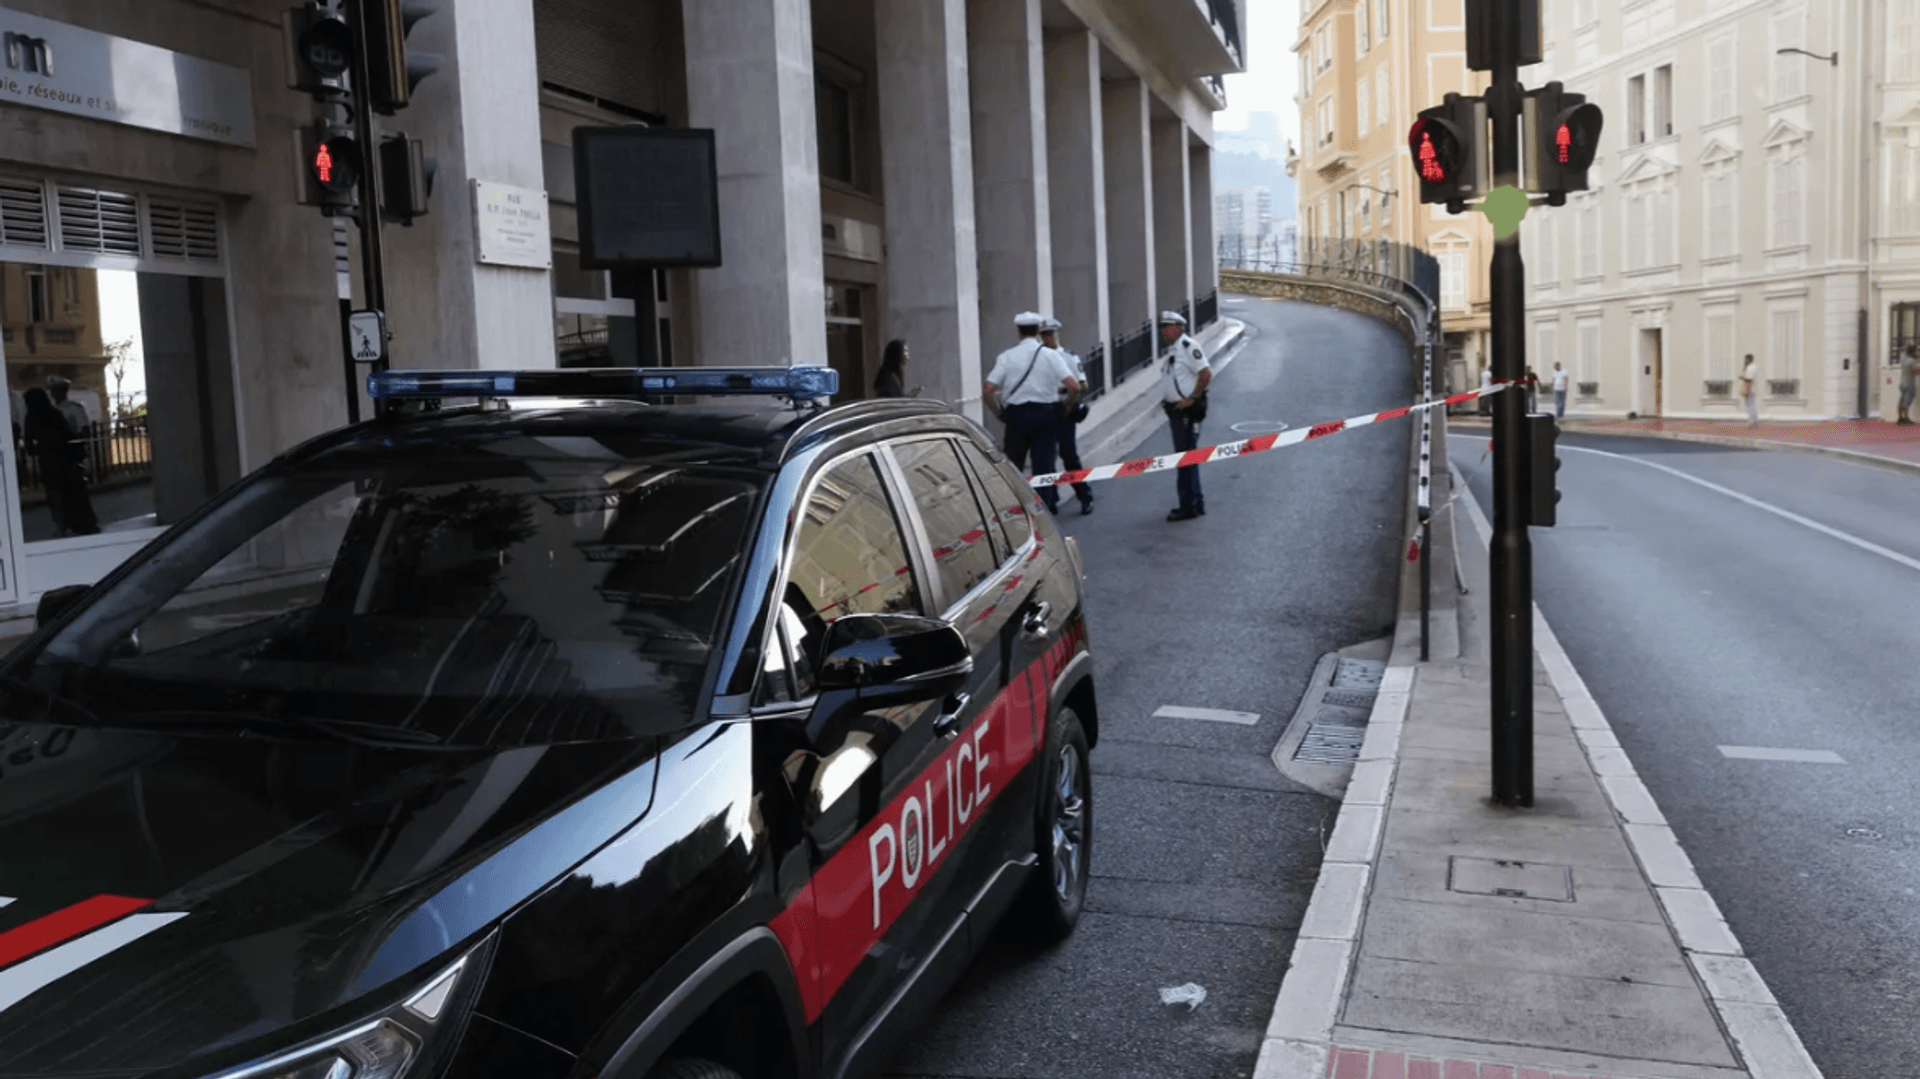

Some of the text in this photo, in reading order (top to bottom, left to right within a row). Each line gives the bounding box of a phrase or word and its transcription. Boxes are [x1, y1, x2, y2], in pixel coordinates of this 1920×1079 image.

[27, 84, 82, 105] réseaux
[87, 97, 101, 109] et
[868, 719, 991, 930] POLICE
